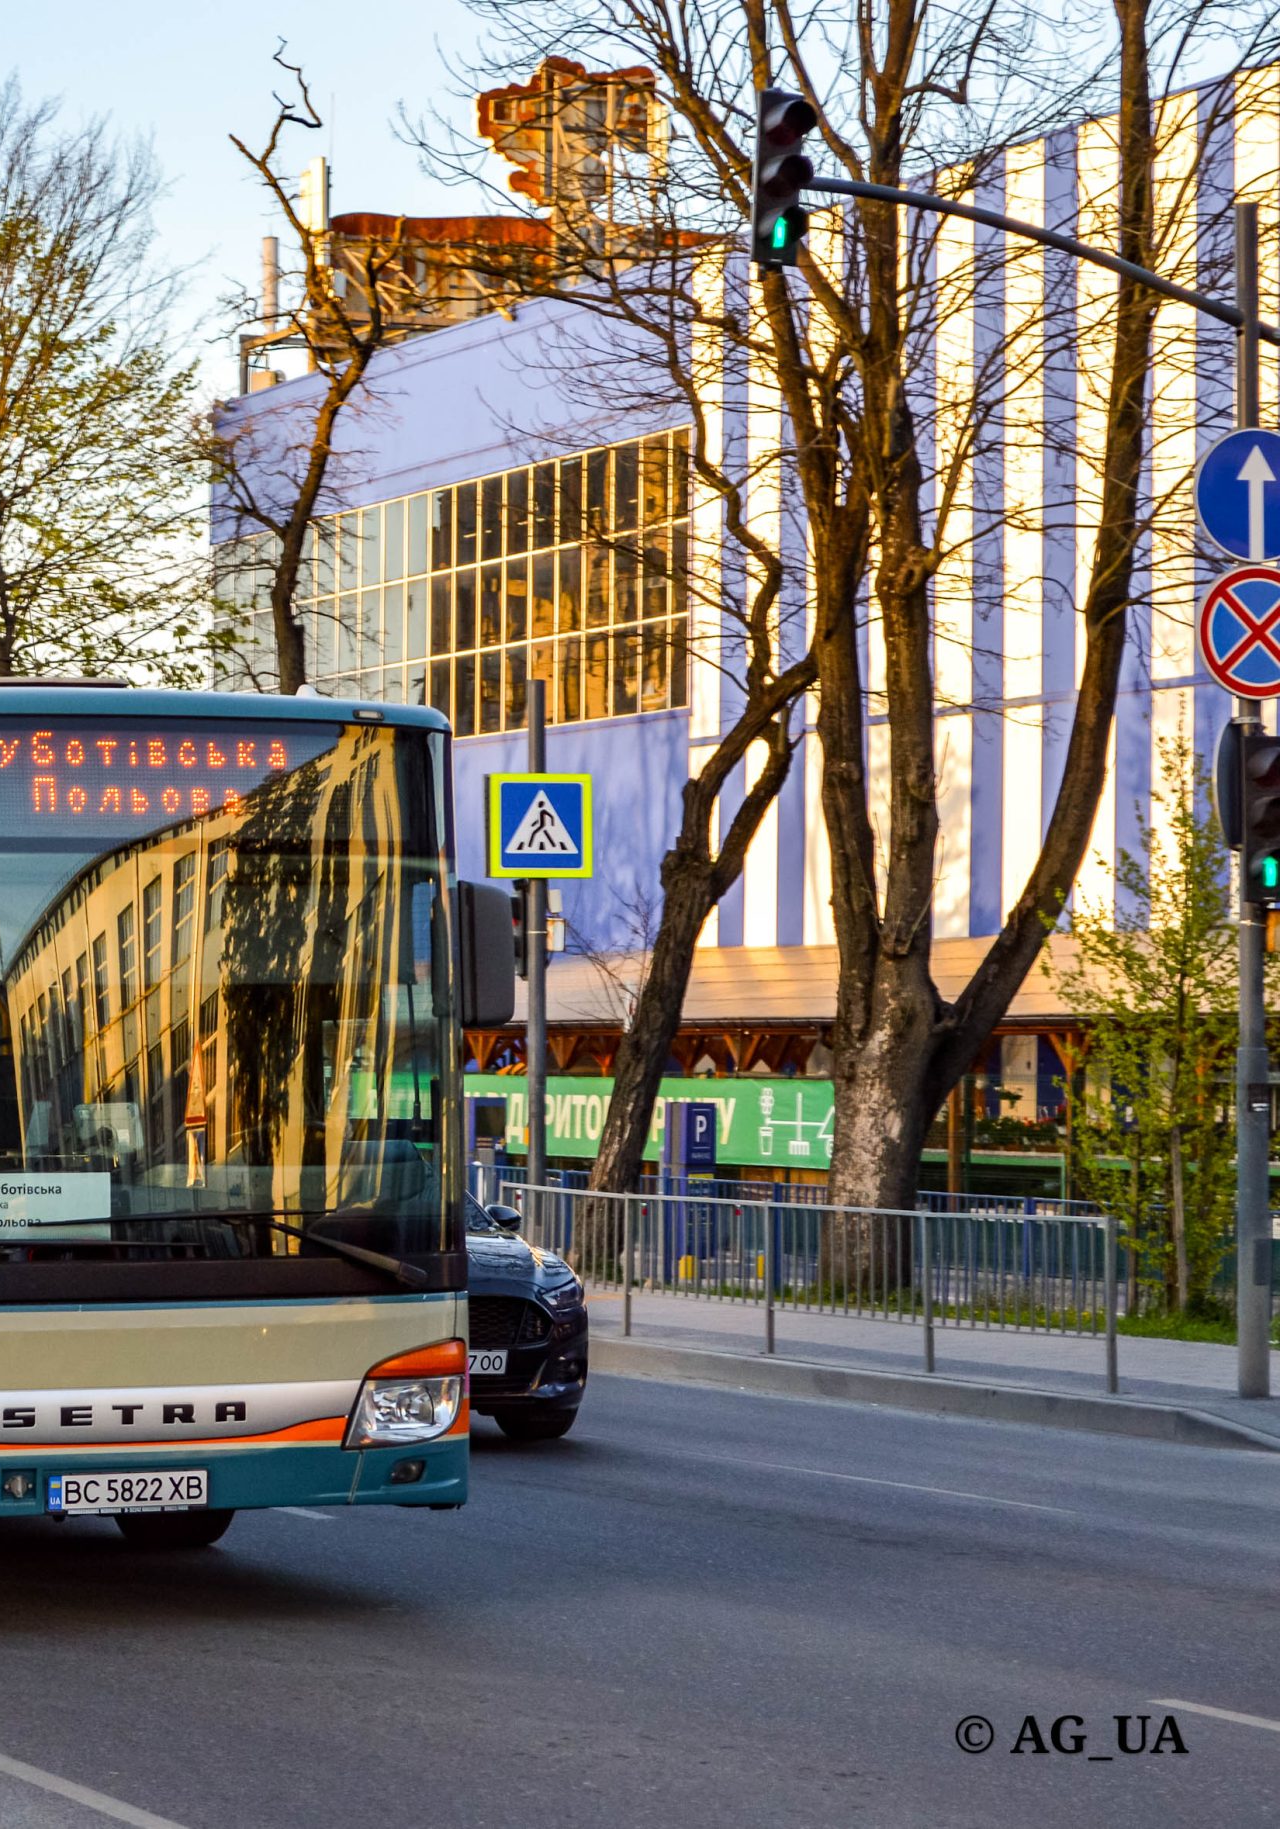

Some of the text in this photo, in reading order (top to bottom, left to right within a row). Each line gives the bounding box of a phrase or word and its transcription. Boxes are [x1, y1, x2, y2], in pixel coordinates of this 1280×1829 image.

[33, 776, 241, 813] Польова
[695, 1115, 708, 1143] P
[2, 1401, 247, 1428] SETRA
[65, 1476, 203, 1504] BC 5822 XB
